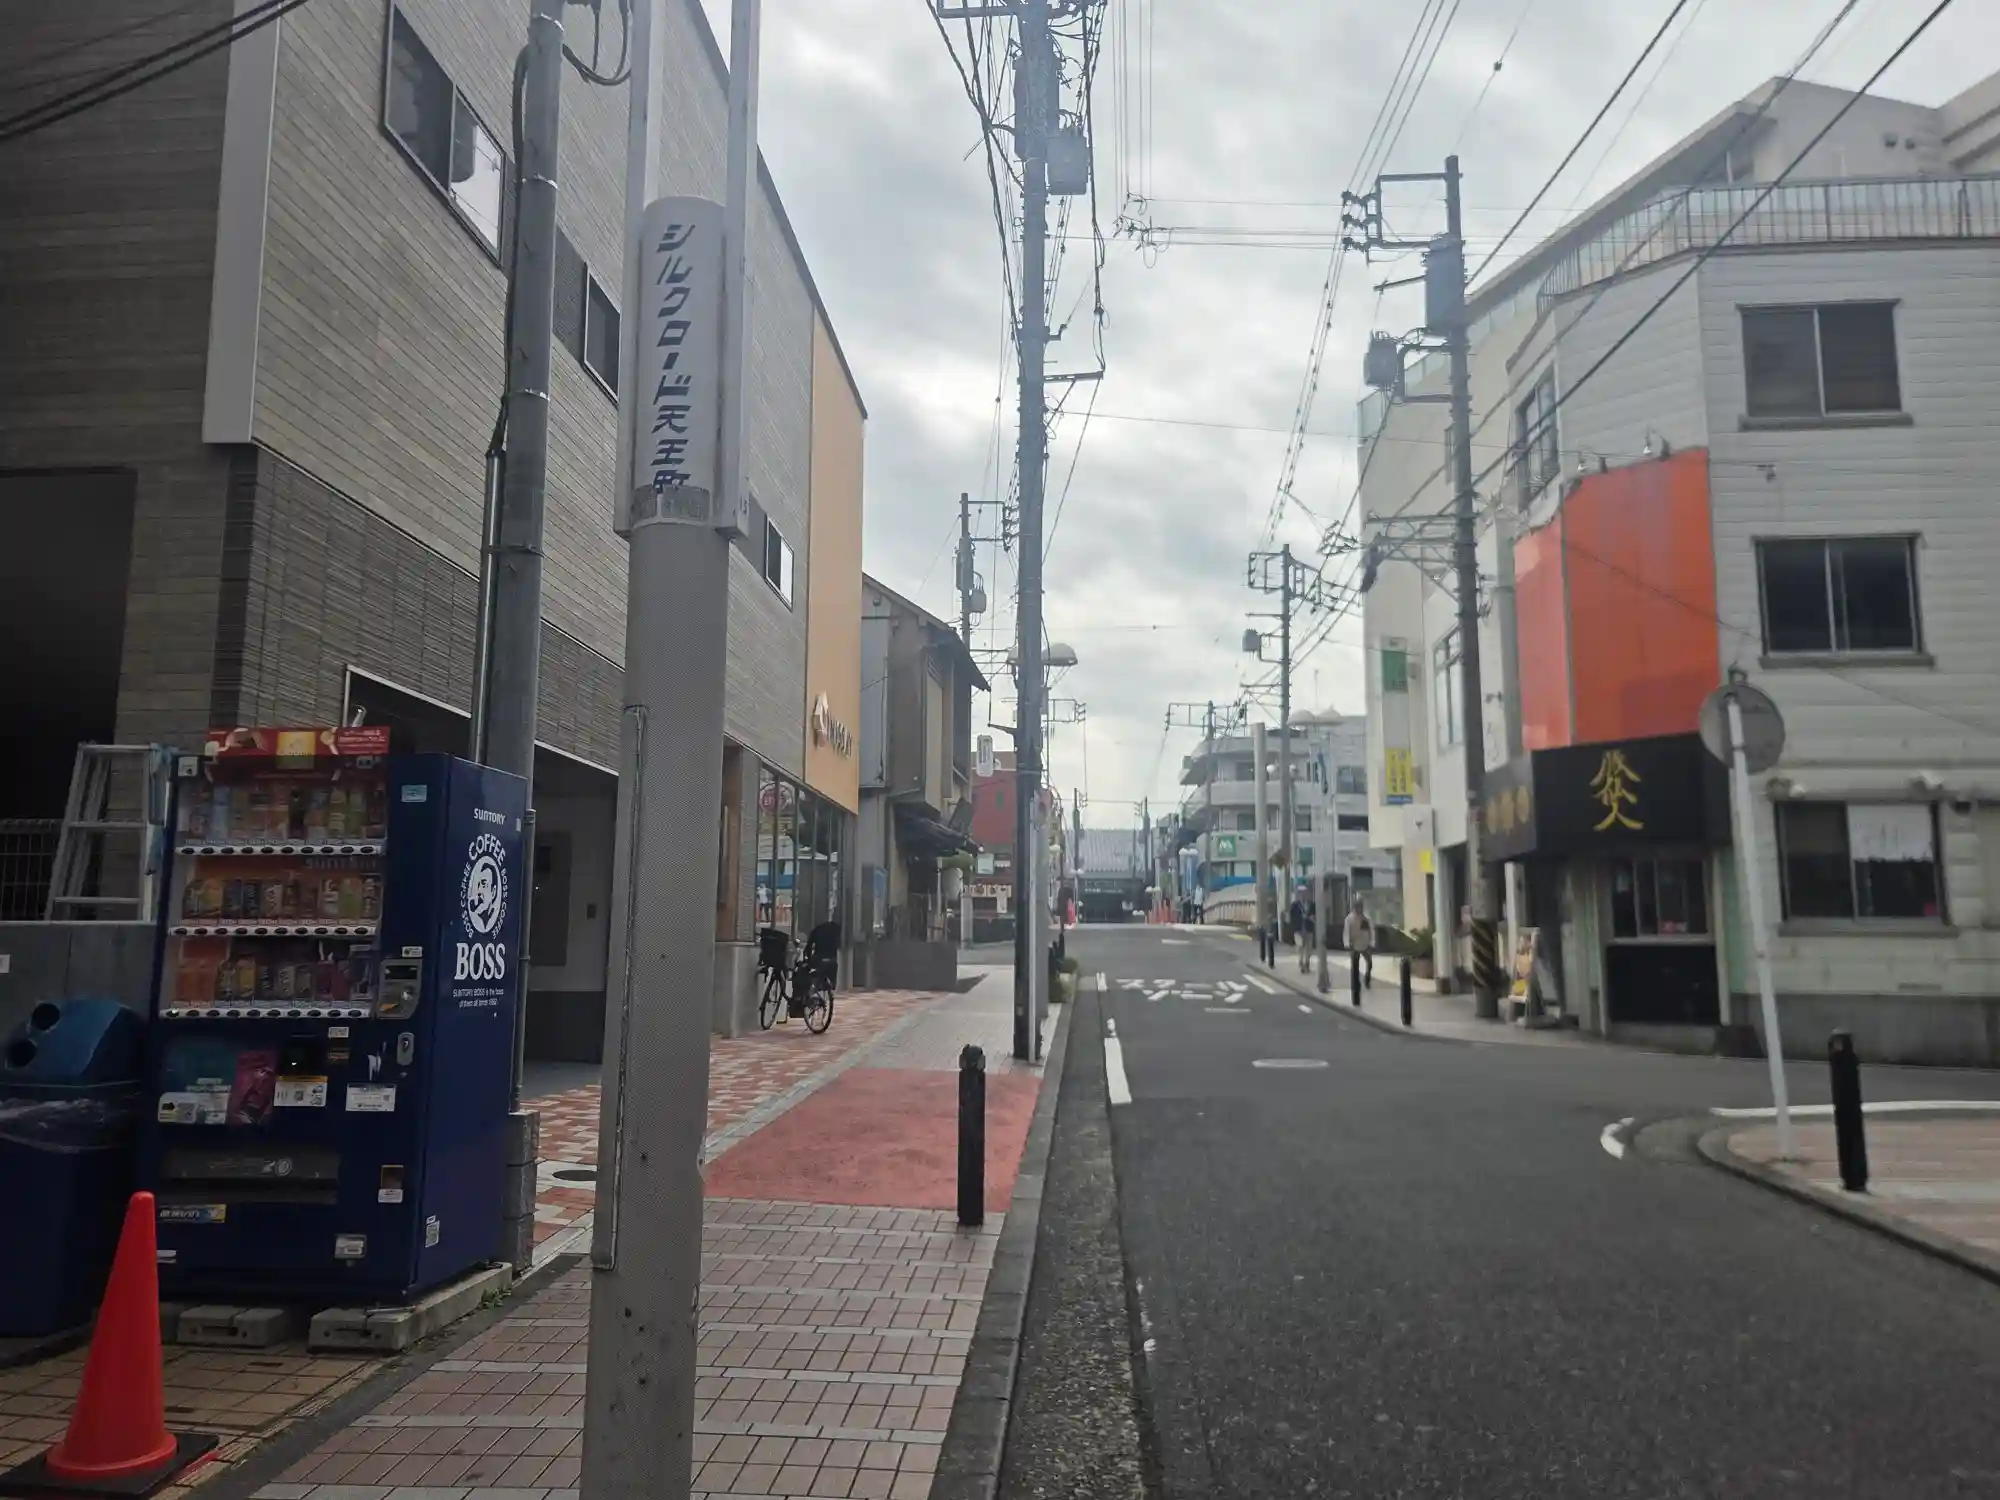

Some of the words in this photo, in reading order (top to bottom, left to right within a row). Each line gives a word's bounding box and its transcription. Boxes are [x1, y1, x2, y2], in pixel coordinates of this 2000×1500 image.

[651, 223, 697, 495] シルクロード天王町
[473, 807, 506, 825] SUNTORY
[468, 833, 507, 867] COFFEE
[453, 941, 507, 981] BOSS
